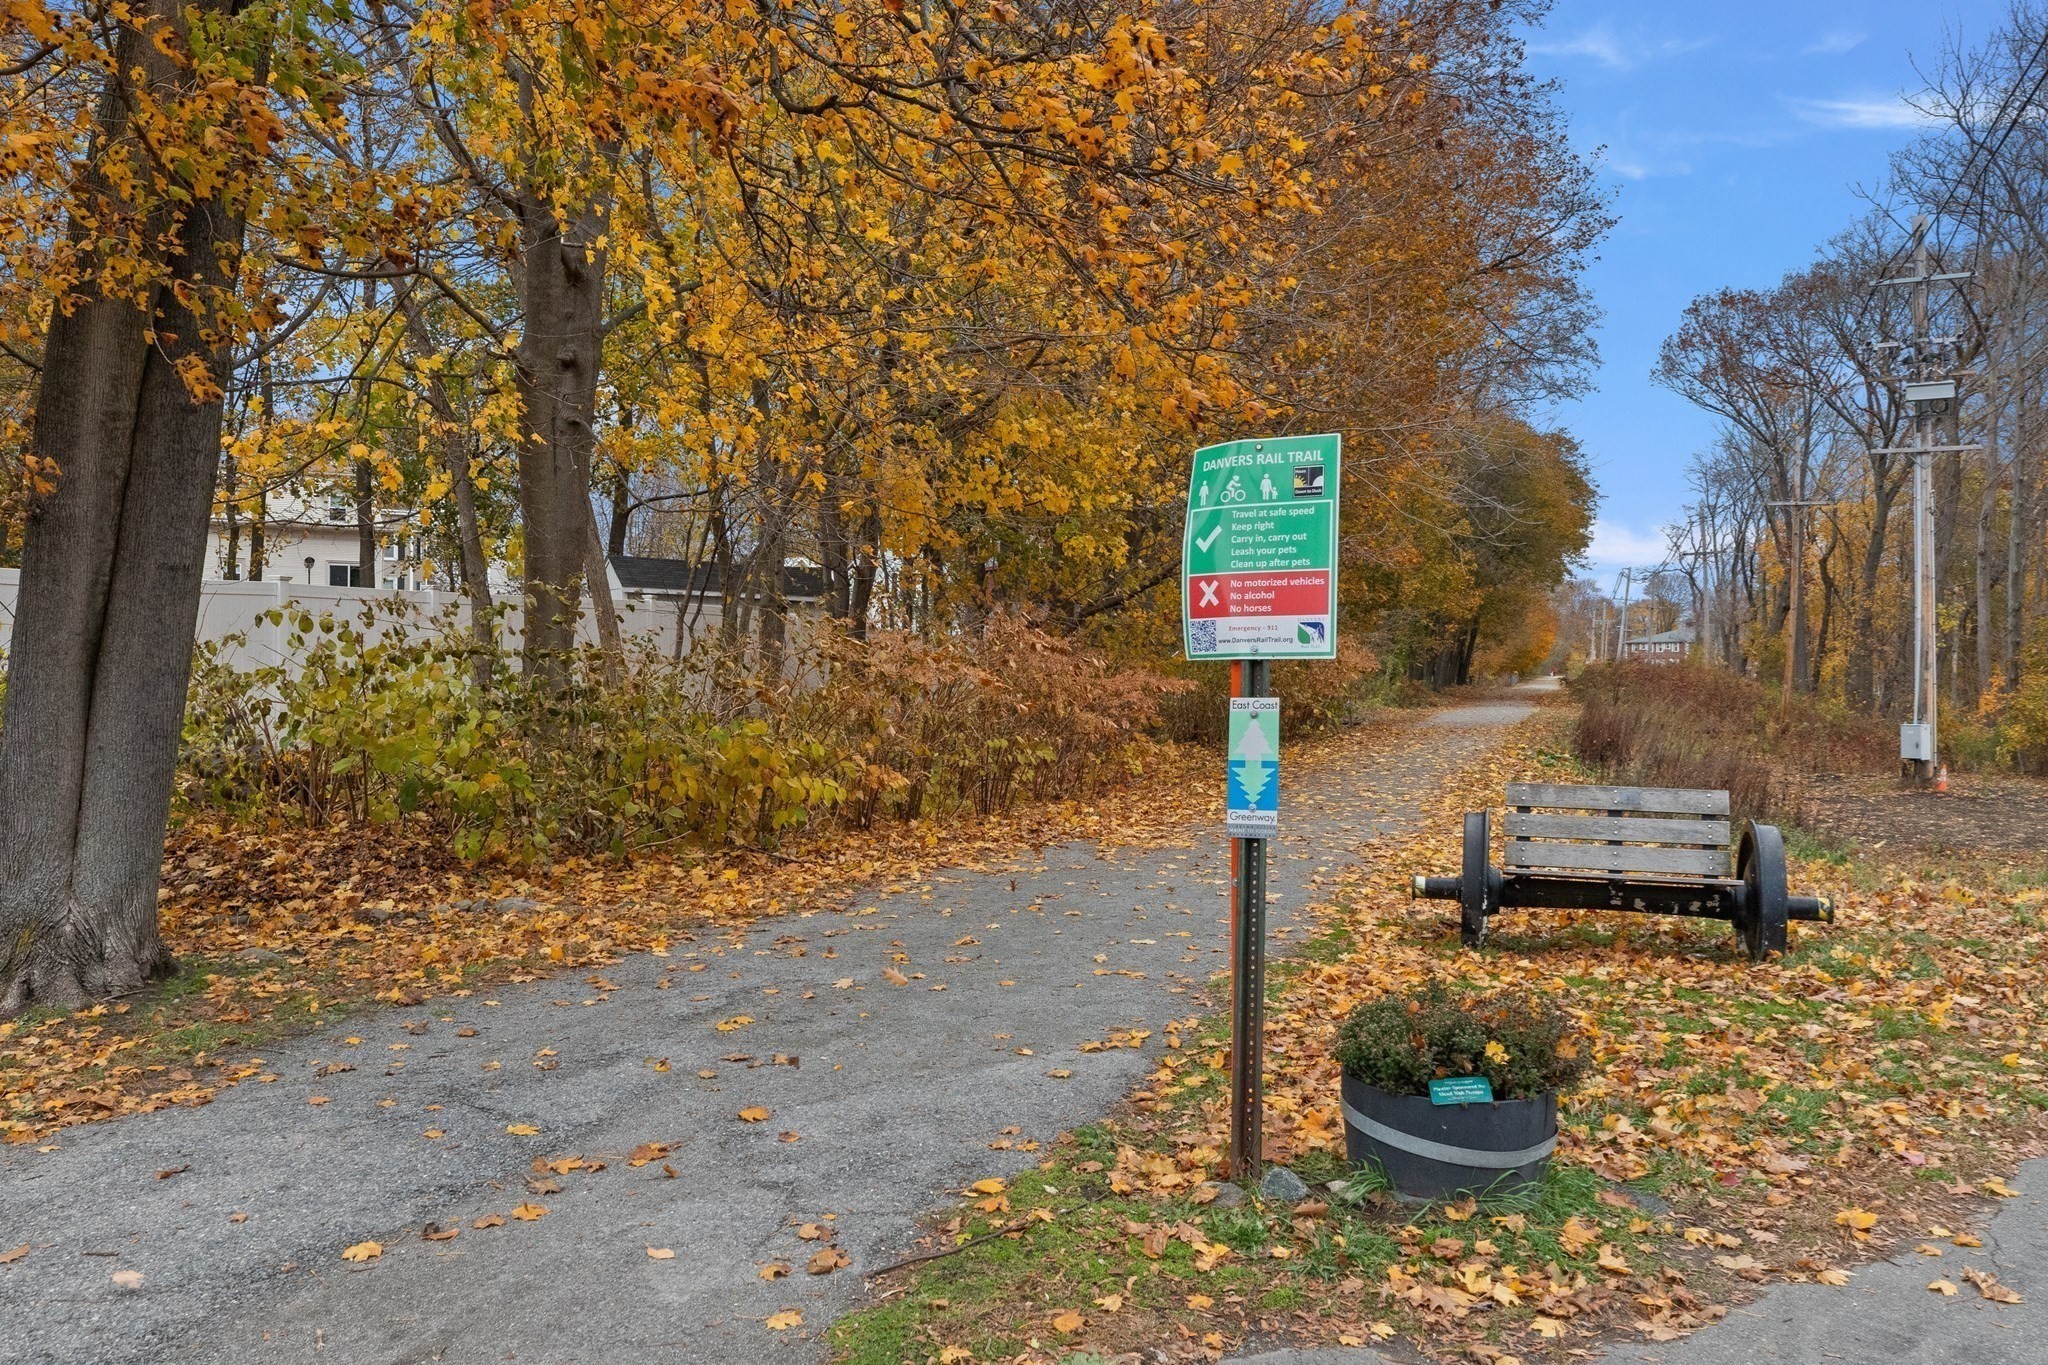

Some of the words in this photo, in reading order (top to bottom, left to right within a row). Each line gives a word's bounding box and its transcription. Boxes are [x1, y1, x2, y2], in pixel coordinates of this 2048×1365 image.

[1203, 455, 1253, 472] DANVERS
[1256, 452, 1284, 465] RAIL
[1288, 450, 1324, 462] TRAIL
[1232, 510, 1256, 518] Travel
[1258, 509, 1267, 517] at
[1269, 507, 1287, 516] safe
[1289, 506, 1315, 518] speed
[1232, 523, 1252, 533] Keep
[1254, 522, 1274, 532] right
[1231, 535, 1252, 546] Carry
[1256, 534, 1266, 542] in,
[1268, 534, 1290, 544] carry
[1231, 548, 1254, 556] Leash
[1256, 548, 1275, 558] your
[1278, 546, 1296, 557] pets
[1231, 560, 1254, 568] Clean
[1256, 560, 1266, 569] up
[1269, 558, 1289, 567] after
[1291, 558, 1310, 569] pets
[1244, 578, 1287, 587] motorized
[1290, 577, 1325, 586] vehicles
[1244, 591, 1275, 600] alcohol
[1244, 604, 1272, 612] horses
[1218, 637, 1294, 646] www.DanversRailTrail.org
[1232, 700, 1250, 709] East
[1252, 700, 1278, 710] Coast
[1230, 812, 1275, 824] Greenway
